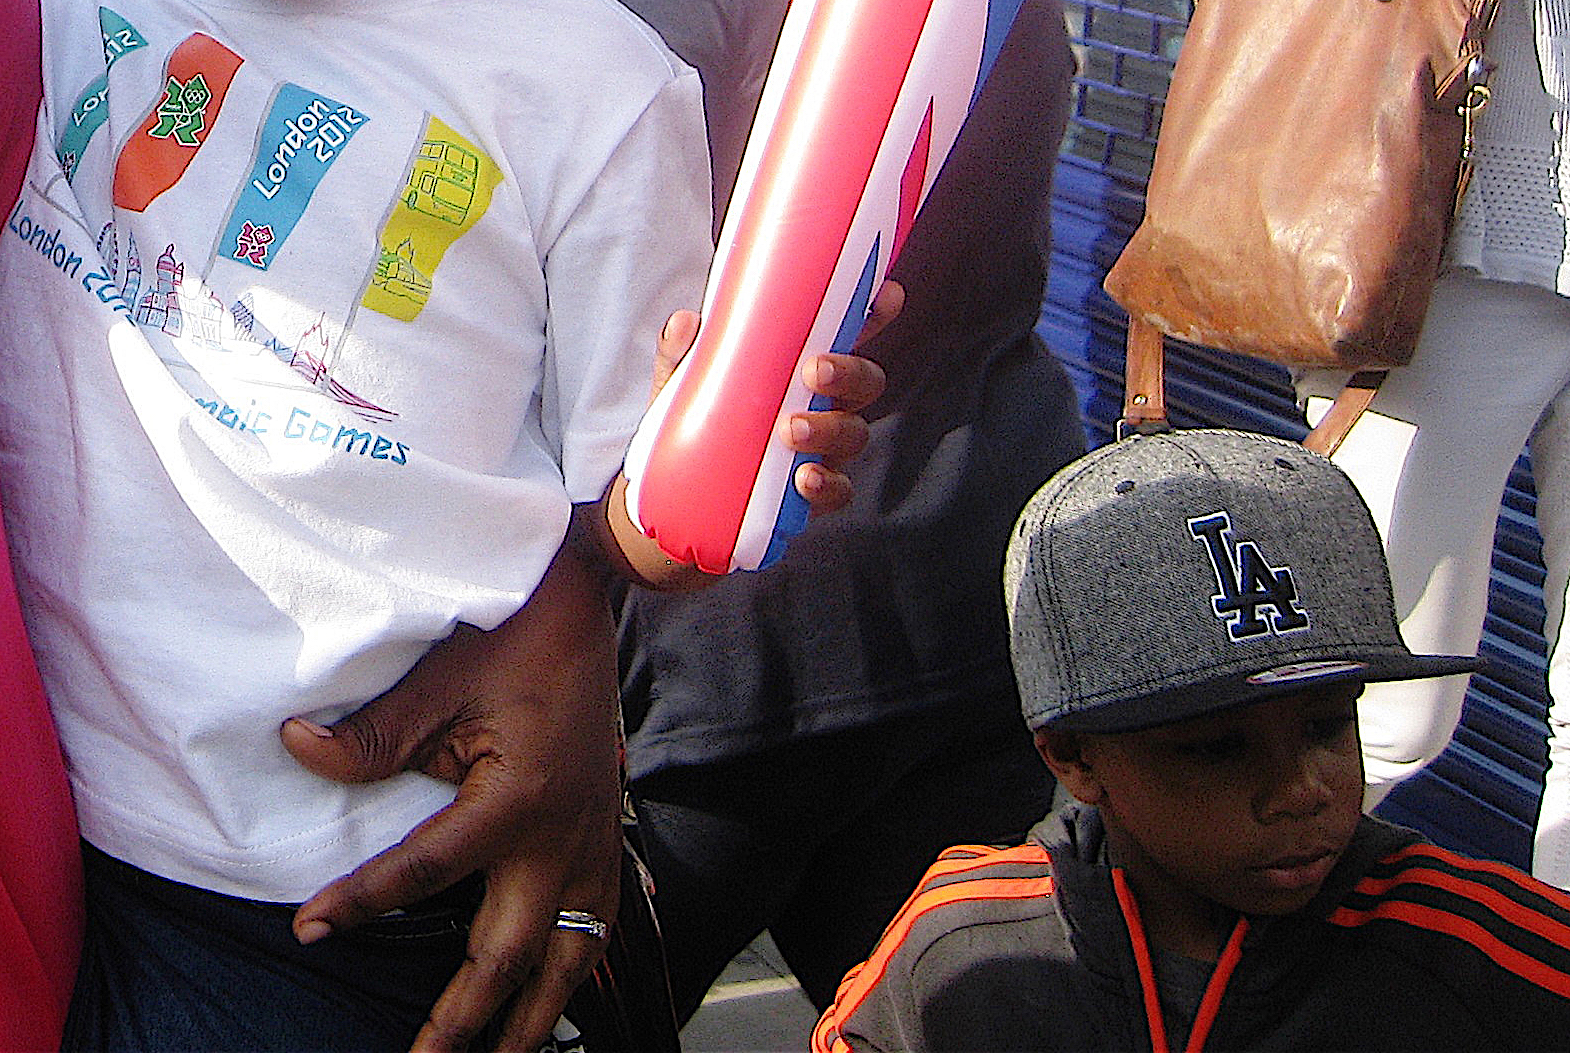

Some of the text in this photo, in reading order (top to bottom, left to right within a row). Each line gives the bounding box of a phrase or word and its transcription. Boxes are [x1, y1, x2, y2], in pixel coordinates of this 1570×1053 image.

[252, 99, 330, 200] London
[306, 106, 363, 163] 2012
[10, 199, 83, 279] London
[284, 406, 410, 466] Games
[1187, 510, 1312, 643] LA
